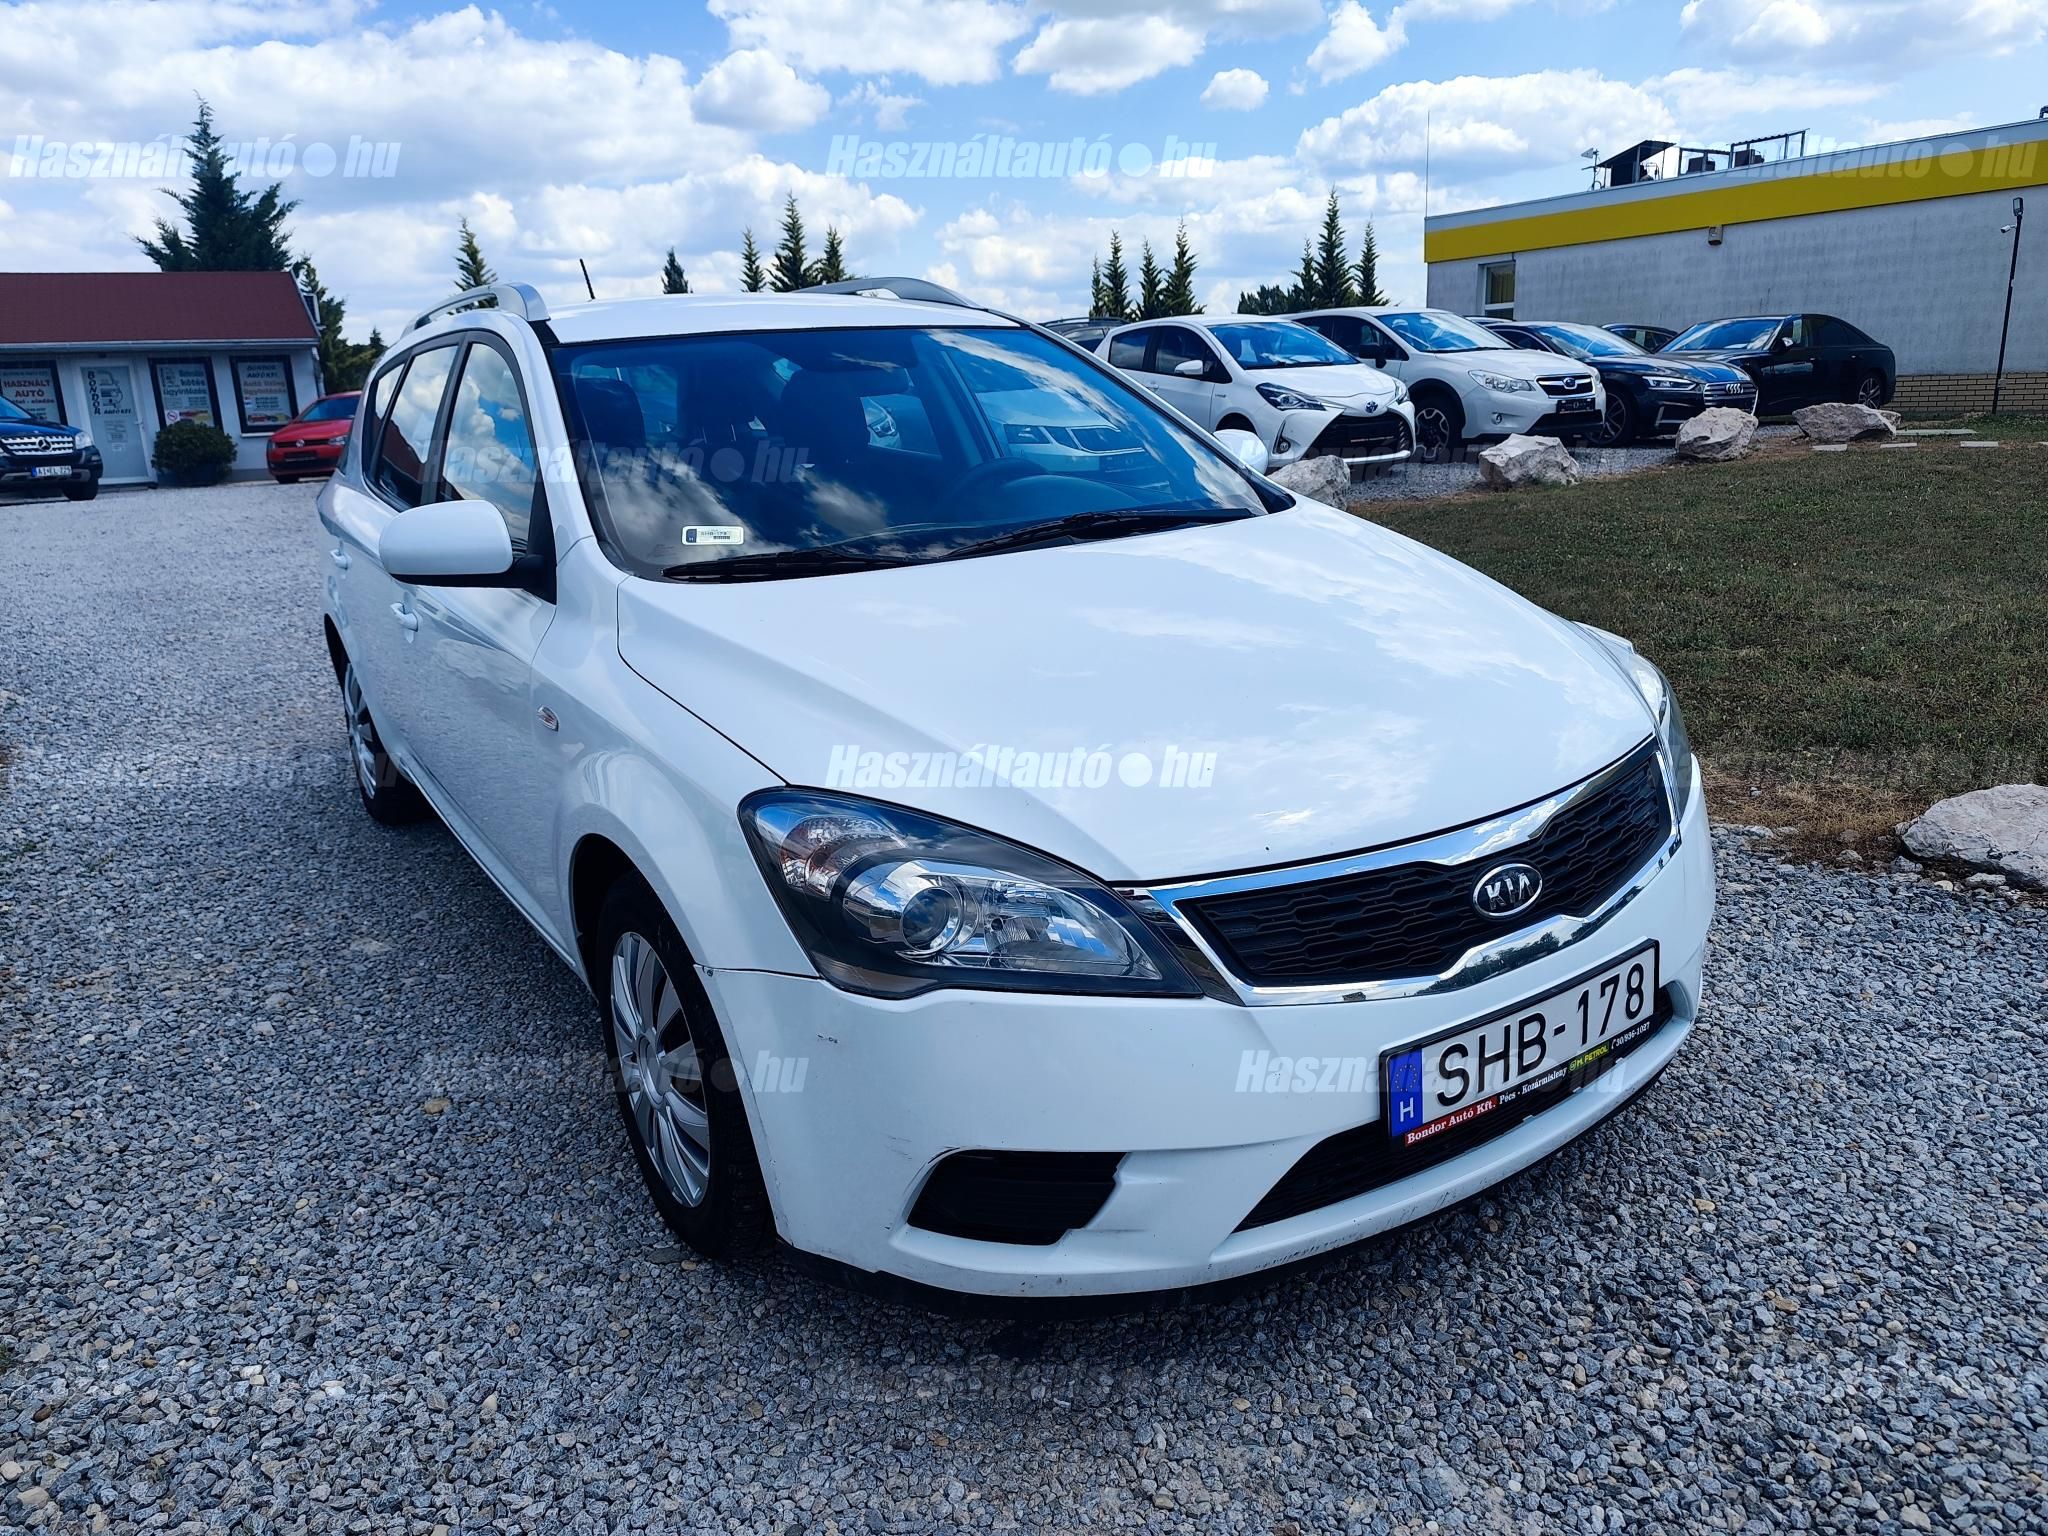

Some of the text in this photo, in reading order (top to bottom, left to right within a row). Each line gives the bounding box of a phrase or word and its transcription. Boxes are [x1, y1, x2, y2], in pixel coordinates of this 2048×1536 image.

[1485, 872, 1534, 910] KIA
[1436, 963, 1644, 1107] SHB-178
[1399, 1097, 1414, 1122] H
[1407, 1121, 1446, 1144] Bondor
[1448, 1108, 1474, 1127] Autó
[1476, 1099, 1496, 1115] Kft.
[1499, 1090, 1516, 1104] Pécs
